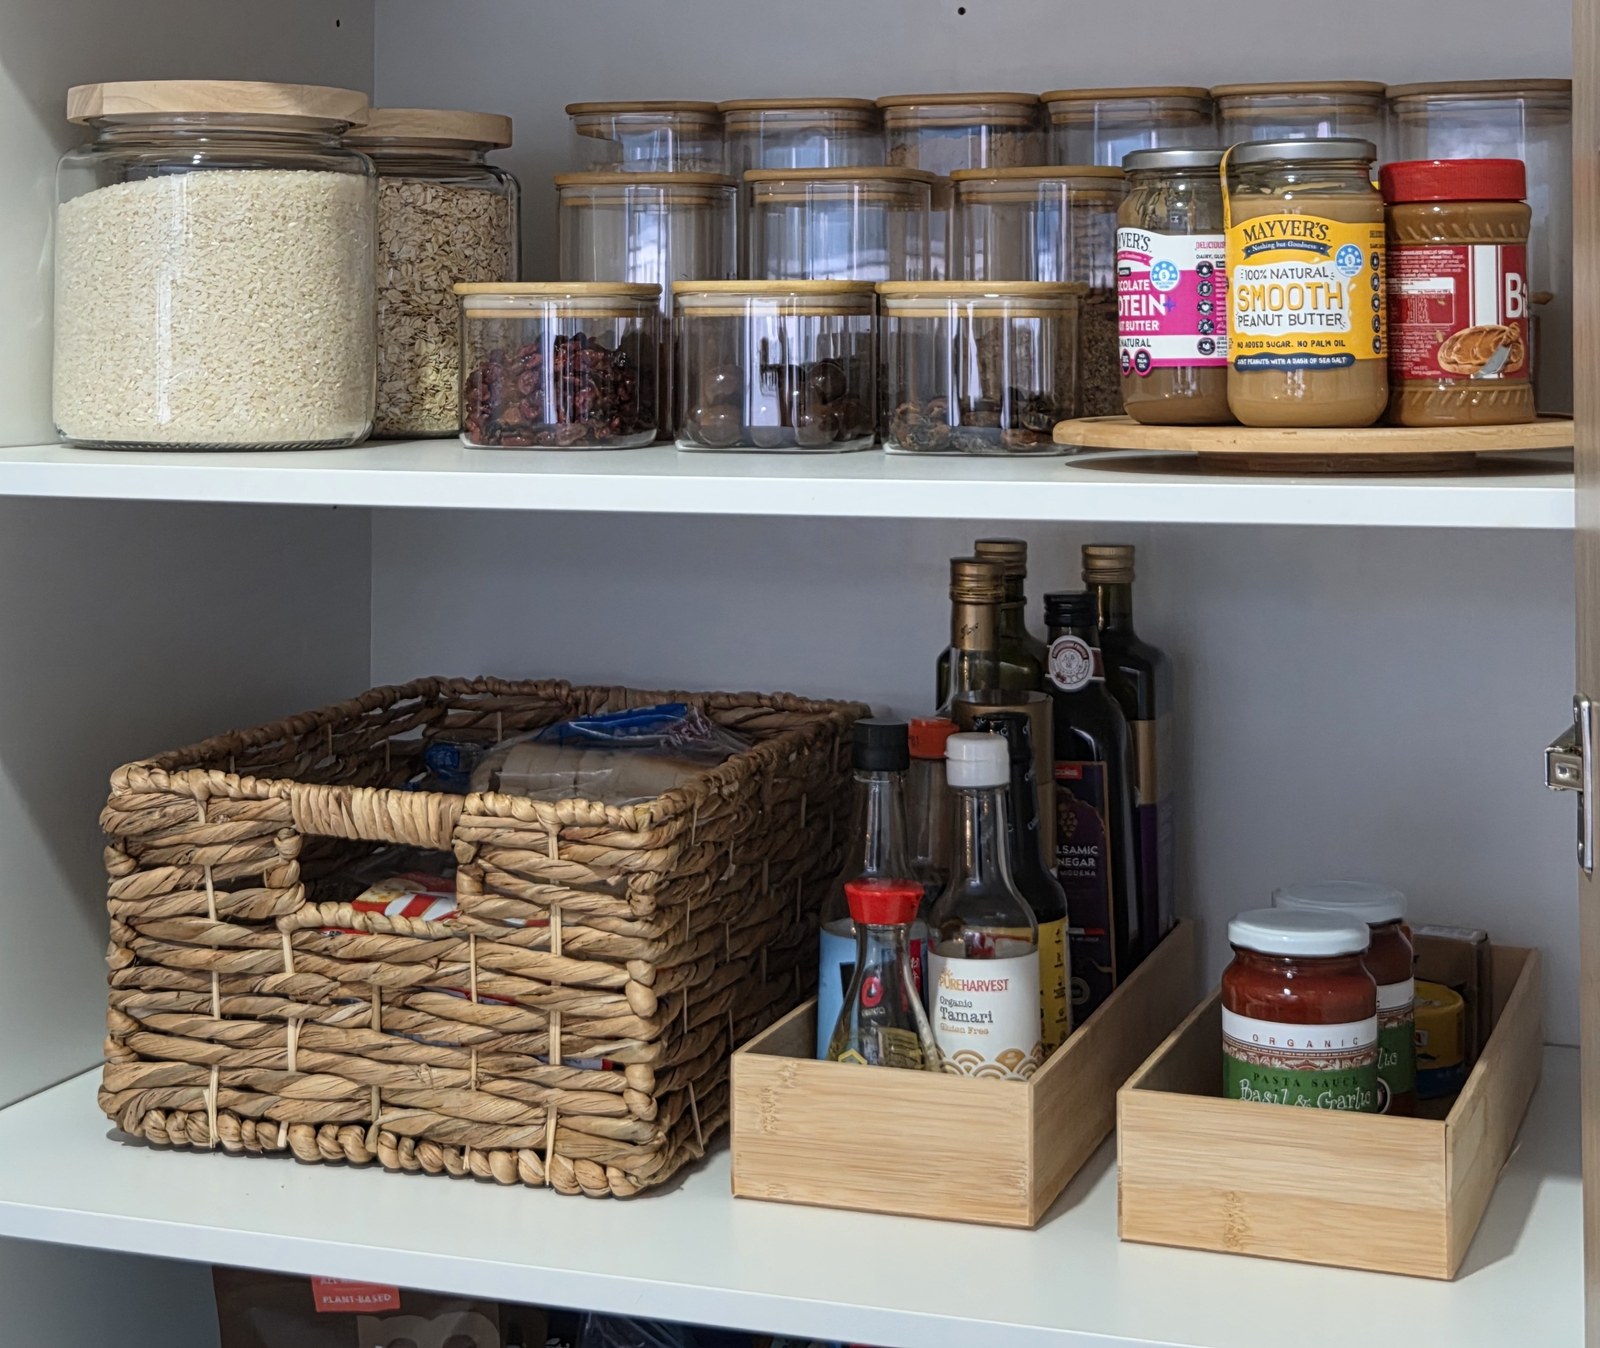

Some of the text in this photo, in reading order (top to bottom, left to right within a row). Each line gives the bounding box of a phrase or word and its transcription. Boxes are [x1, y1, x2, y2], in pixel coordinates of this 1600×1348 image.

[1242, 219, 1329, 244] MAYVER'S
[1251, 242, 1275, 252] Nothing
[1287, 240, 1317, 250] Goodness
[1244, 269, 1267, 281] 100%
[1270, 267, 1329, 280] NATURAL
[1237, 281, 1344, 312] SMOOTH
[1126, 320, 1160, 331] BUTTER
[1238, 313, 1342, 327] PEANUT BUTTER
[1245, 341, 1264, 349] ADDED
[1297, 340, 1308, 348] NO
[1334, 339, 1346, 347] OIL
[939, 996, 973, 1008] Organic
[939, 1007, 994, 1023] Tamari
[1252, 1034, 1358, 1048] ORGANIC
[1253, 1072, 1359, 1088] PASTA SAUCE
[1239, 1078, 1372, 1110] Basil & Garlic
[322, 1293, 392, 1304] PLANT-BASED
